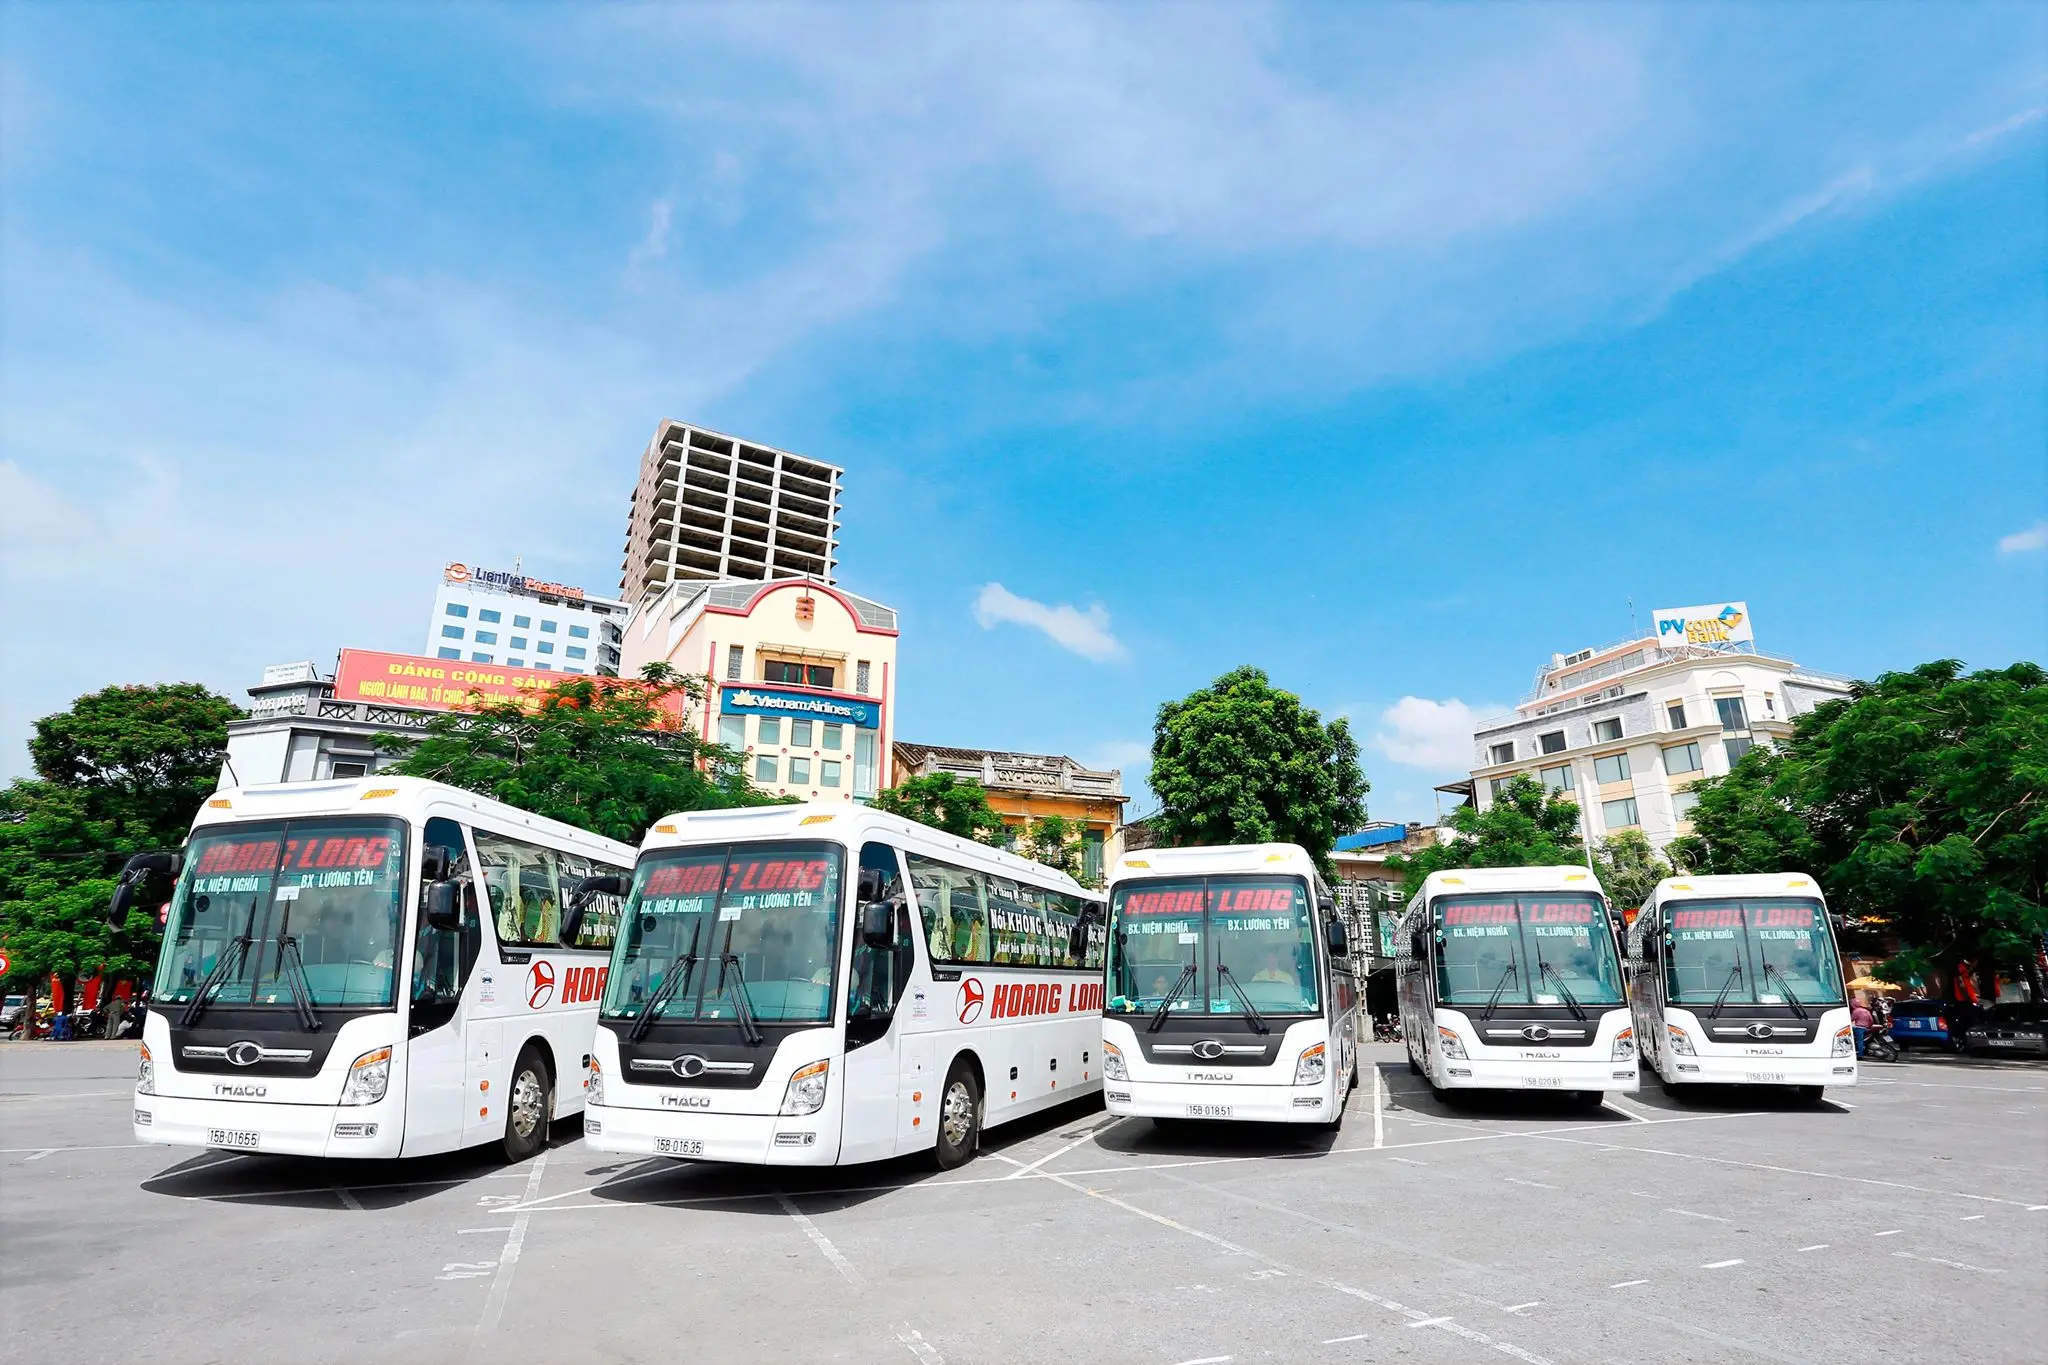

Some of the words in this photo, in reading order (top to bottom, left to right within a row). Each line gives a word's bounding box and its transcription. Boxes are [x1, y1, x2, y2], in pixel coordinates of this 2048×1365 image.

[388, 662, 446, 679] ĐẢNG
[451, 670, 505, 686] CỘNG
[511, 675, 552, 690] SẢN
[386, 682, 410, 699] LÃNH
[298, 837, 390, 869] LONG
[318, 871, 351, 888] LƯƠNG
[352, 870, 374, 885] YÊN
[739, 860, 828, 890] LONG
[207, 876, 231, 895] NIỆM
[654, 898, 676, 916] NIỆM
[759, 894, 792, 910] LƯƠNG
[792, 893, 812, 907] YÊN
[1217, 888, 1292, 912] LONG
[1007, 908, 1042, 935] KHÔNG
[1529, 903, 1592, 924] LONG
[1755, 908, 1813, 927] LONG
[1142, 922, 1162, 936] NIỆM
[1227, 919, 1243, 931] BX.
[1273, 917, 1290, 930] YÊN
[1467, 926, 1485, 938] NIỆM
[1574, 925, 1590, 937] YÊN
[1695, 930, 1712, 942] NIỆM
[1796, 929, 1811, 940] YÊN
[990, 982, 1062, 1019] HOANG
[1517, 1051, 1561, 1059] THACO
[1744, 1047, 1784, 1055] THACO
[1185, 1071, 1234, 1081] THACO
[212, 1082, 266, 1097] THACO
[659, 1093, 710, 1108] THACO
